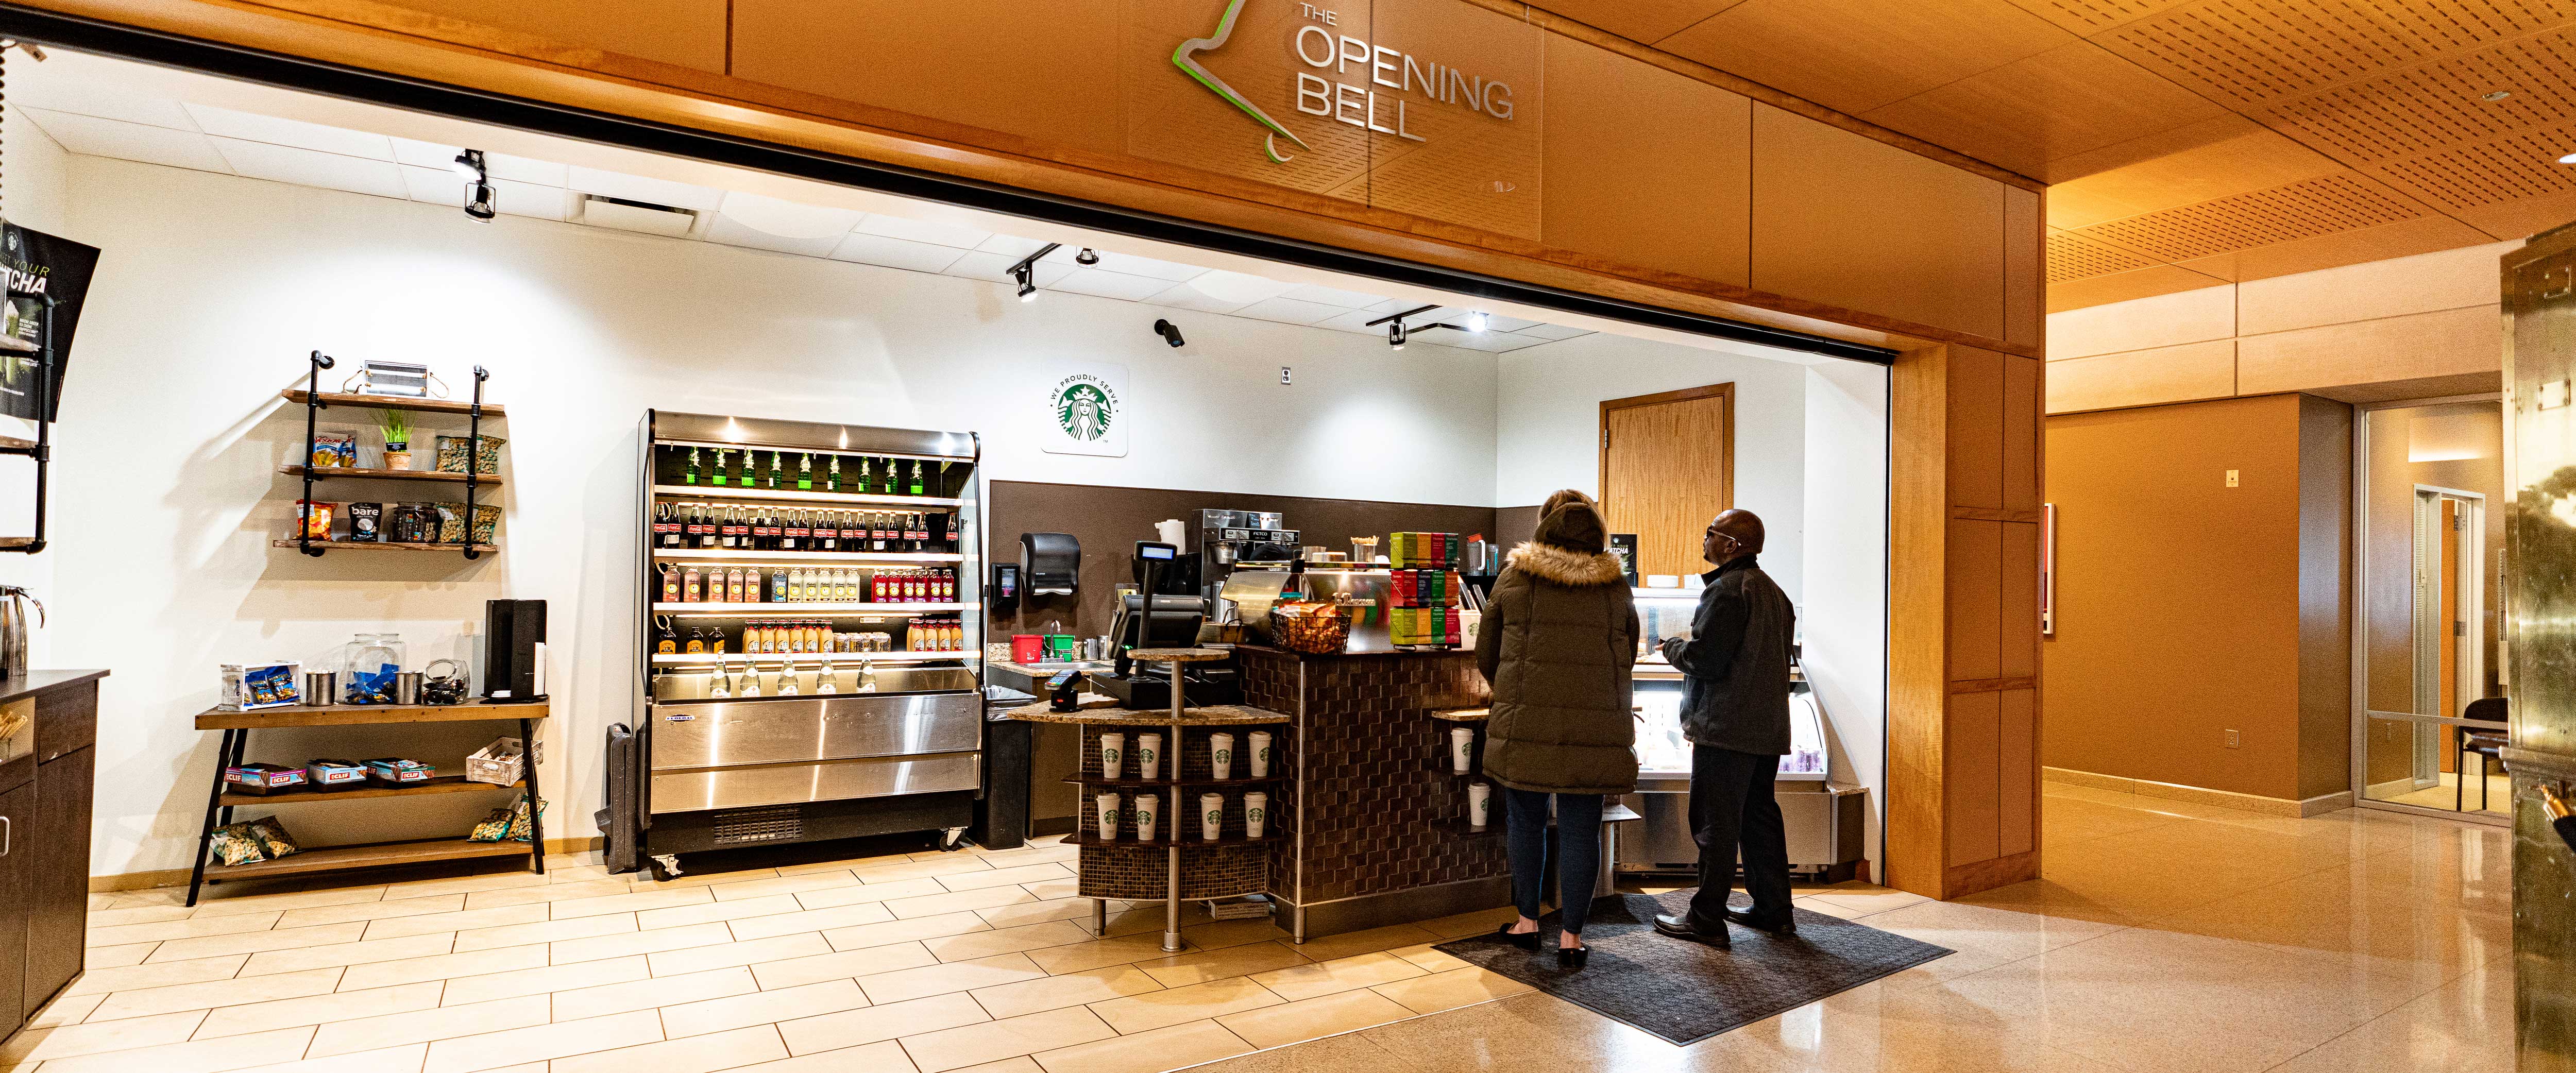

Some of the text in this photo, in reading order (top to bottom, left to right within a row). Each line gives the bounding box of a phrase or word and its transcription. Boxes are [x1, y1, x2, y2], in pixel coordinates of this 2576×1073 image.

[1300, 2, 1337, 26] THE
[1296, 25, 1514, 120] OPENING
[1297, 72, 1426, 142] BELL
[0, 262, 47, 293] TCHA
[14, 259, 49, 276] YOUR
[1050, 374, 1118, 404] WE PROUDLY SERVE
[351, 506, 379, 516] bare
